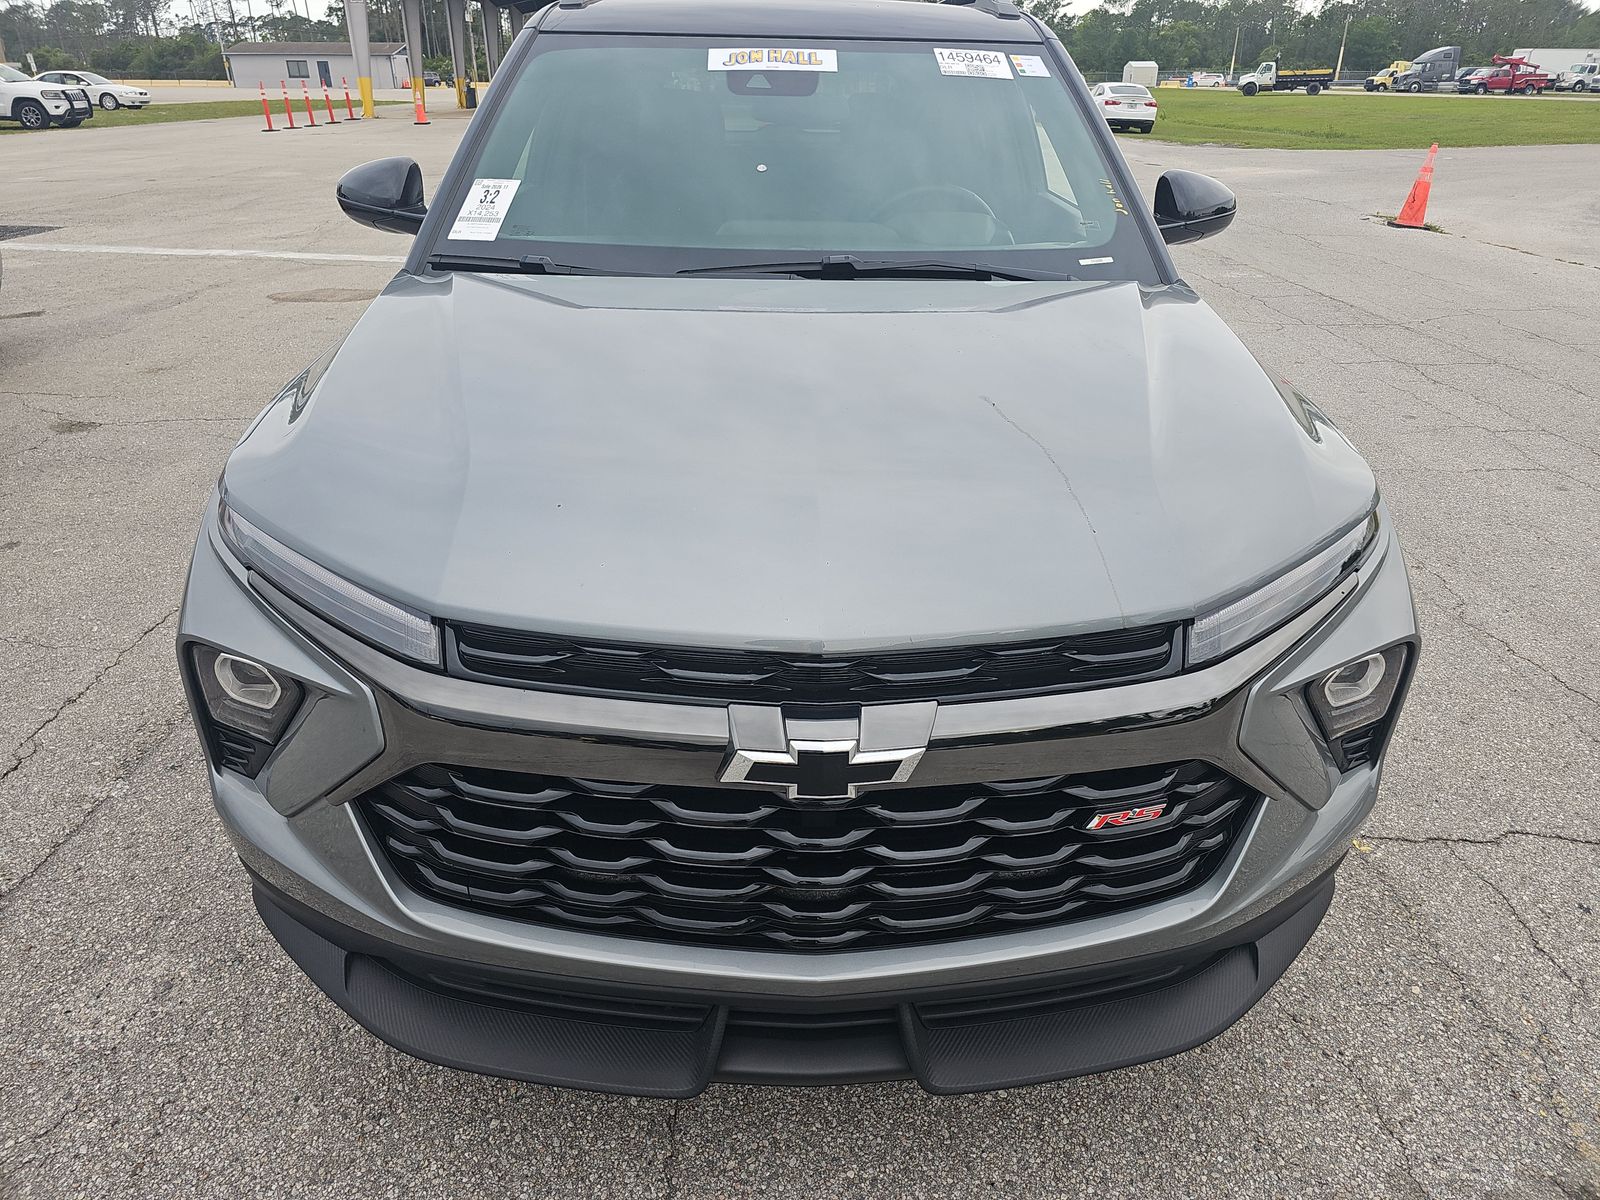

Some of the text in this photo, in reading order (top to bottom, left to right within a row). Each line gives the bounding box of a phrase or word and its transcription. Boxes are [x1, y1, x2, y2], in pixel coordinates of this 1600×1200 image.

[722, 49, 823, 66] JON HALL
[938, 51, 1002, 65] 1459464
[480, 189, 500, 204] 3:2
[1086, 804, 1168, 830] RS
